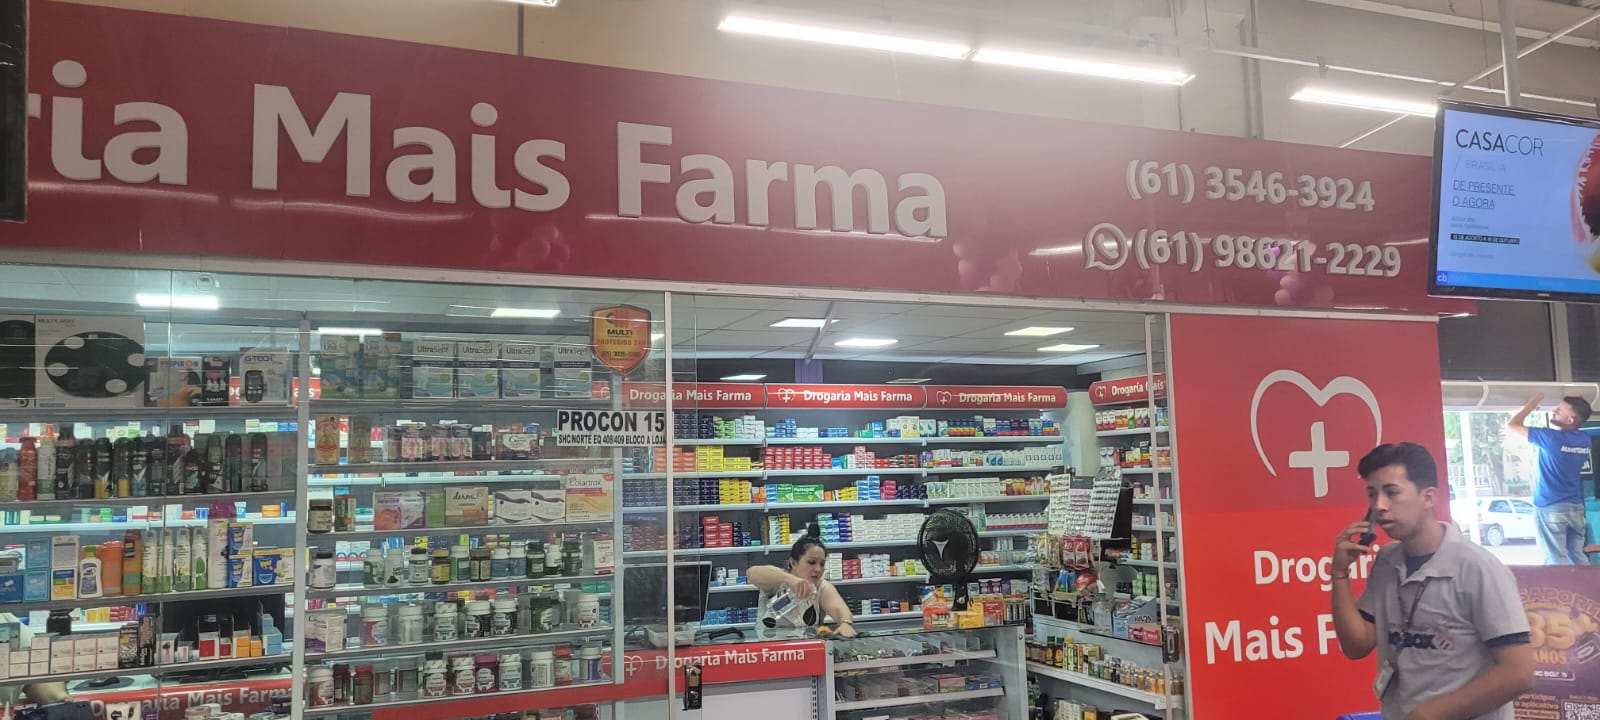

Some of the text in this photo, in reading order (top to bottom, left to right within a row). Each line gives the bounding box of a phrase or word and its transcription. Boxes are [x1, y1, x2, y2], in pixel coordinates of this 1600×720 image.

[28, 59, 948, 239] ia Mais Farma
[1455, 128, 1544, 157] CASACOR
[1126, 159, 1377, 212] (61) 3546-3924
[1453, 179, 1466, 192] DE
[1452, 195, 1495, 209] O AGORA
[1135, 228, 1401, 278] (61) 98621-2229
[686, 387, 713, 401] Mais
[716, 388, 752, 401] Farma
[803, 388, 912, 404] Drogaria Mais Farma
[1111, 380, 1144, 397] Drogaria
[959, 390, 1056, 406] Drogaria Mais Farma
[558, 411, 665, 433] PROCON 15
[626, 435, 645, 445] BLOCO
[647, 435, 651, 445] A
[1205, 615, 1304, 665] Mais
[725, 649, 758, 665] Mais
[762, 648, 805, 663] Farma
[187, 690, 233, 709] Mais
